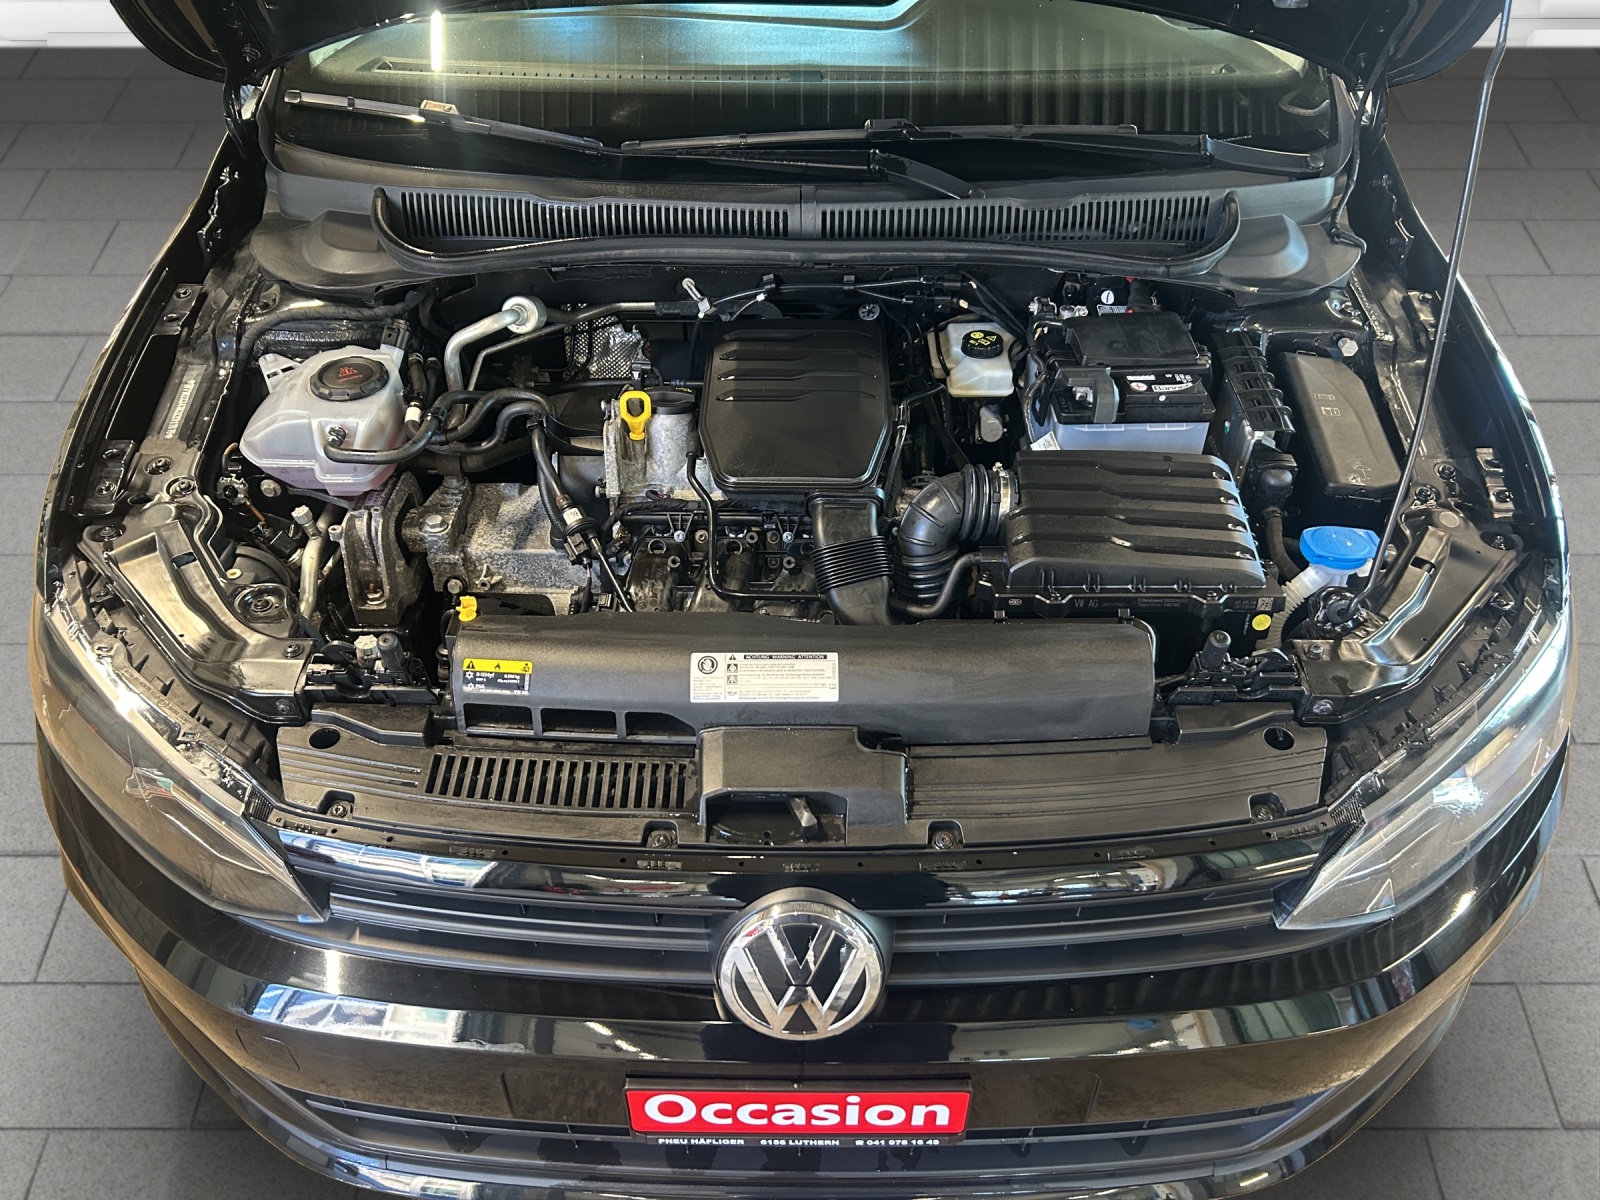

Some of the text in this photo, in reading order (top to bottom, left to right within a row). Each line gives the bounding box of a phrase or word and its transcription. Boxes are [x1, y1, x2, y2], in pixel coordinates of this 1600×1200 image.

[1074, 599, 1084, 608] VW
[1088, 599, 1099, 608] AG
[644, 1093, 950, 1126] Occasion
